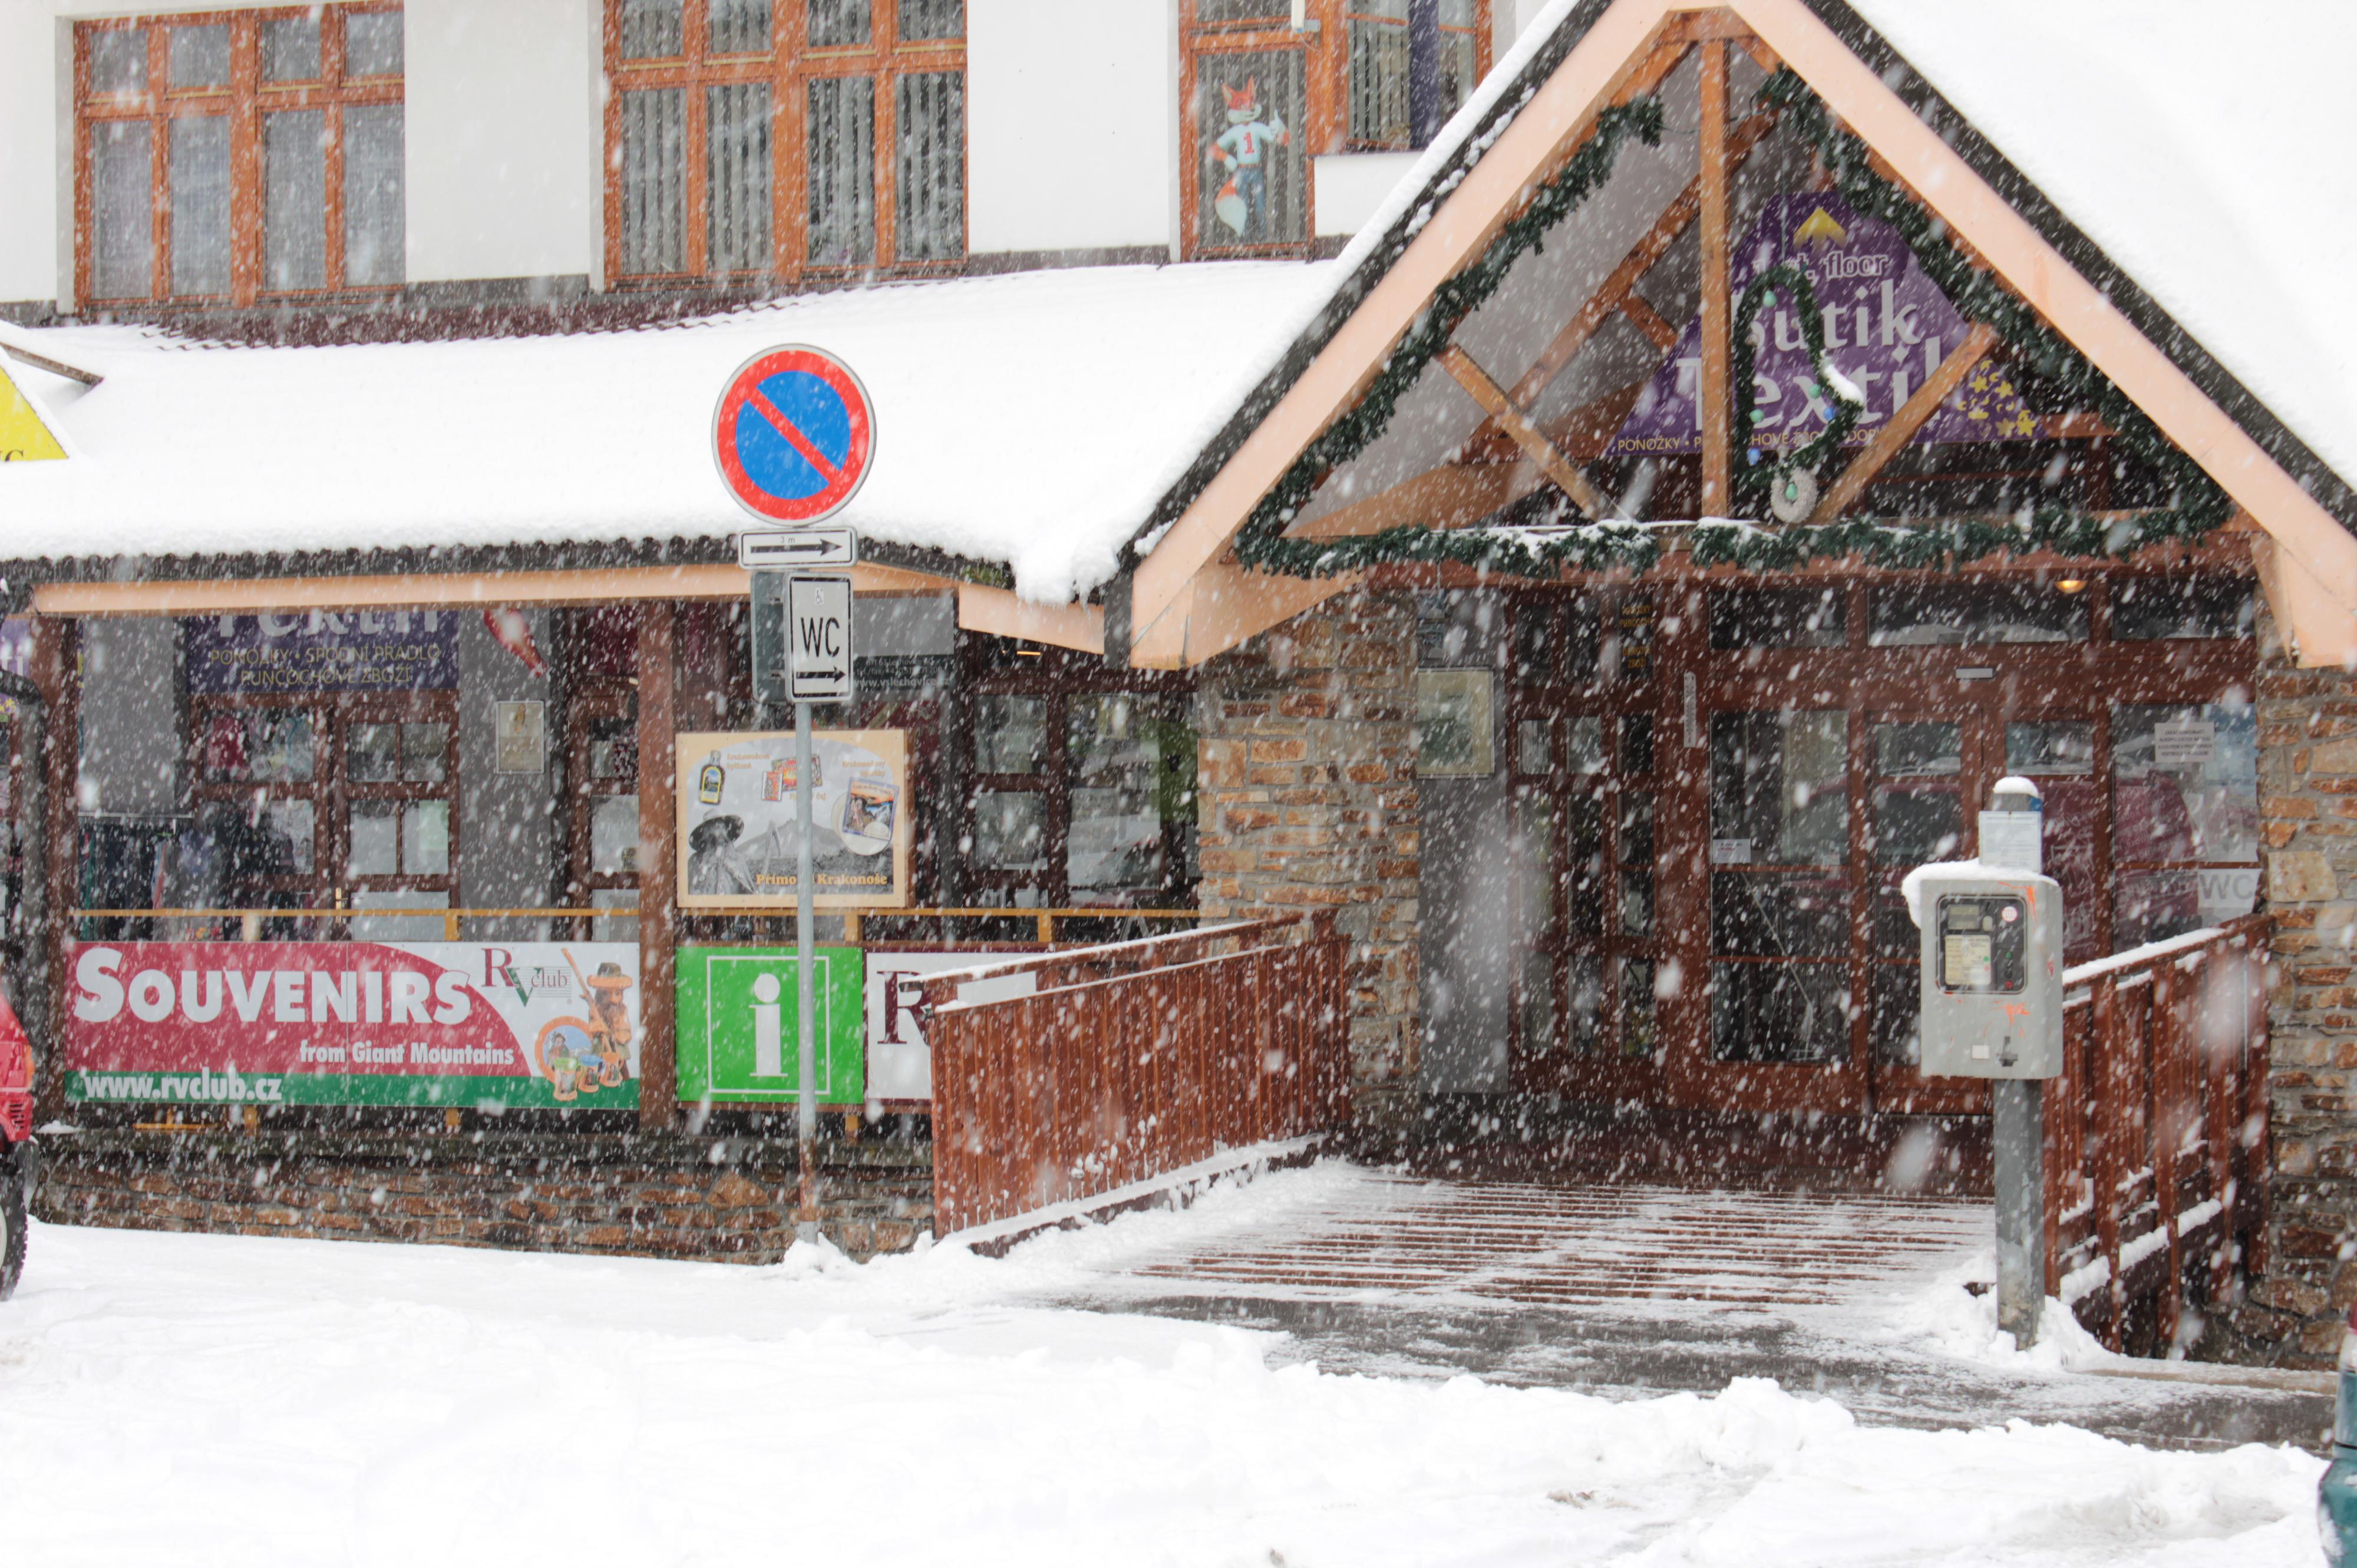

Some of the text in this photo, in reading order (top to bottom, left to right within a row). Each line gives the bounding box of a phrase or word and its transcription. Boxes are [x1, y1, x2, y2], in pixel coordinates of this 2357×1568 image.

[1824, 250, 1889, 279] floor
[1618, 435, 1681, 451] PONOŽKY
[801, 617, 840, 658] WC
[374, 642, 441, 661] PRÁDLO
[755, 873, 797, 885] Přímo
[817, 873, 887, 885] Krakonoše
[2198, 874, 2254, 900] WC
[74, 947, 471, 1023] SOUVENIRS
[300, 1039, 514, 1065] from Giant Mountains
[85, 1067, 283, 1100] www.rvclub.cz
